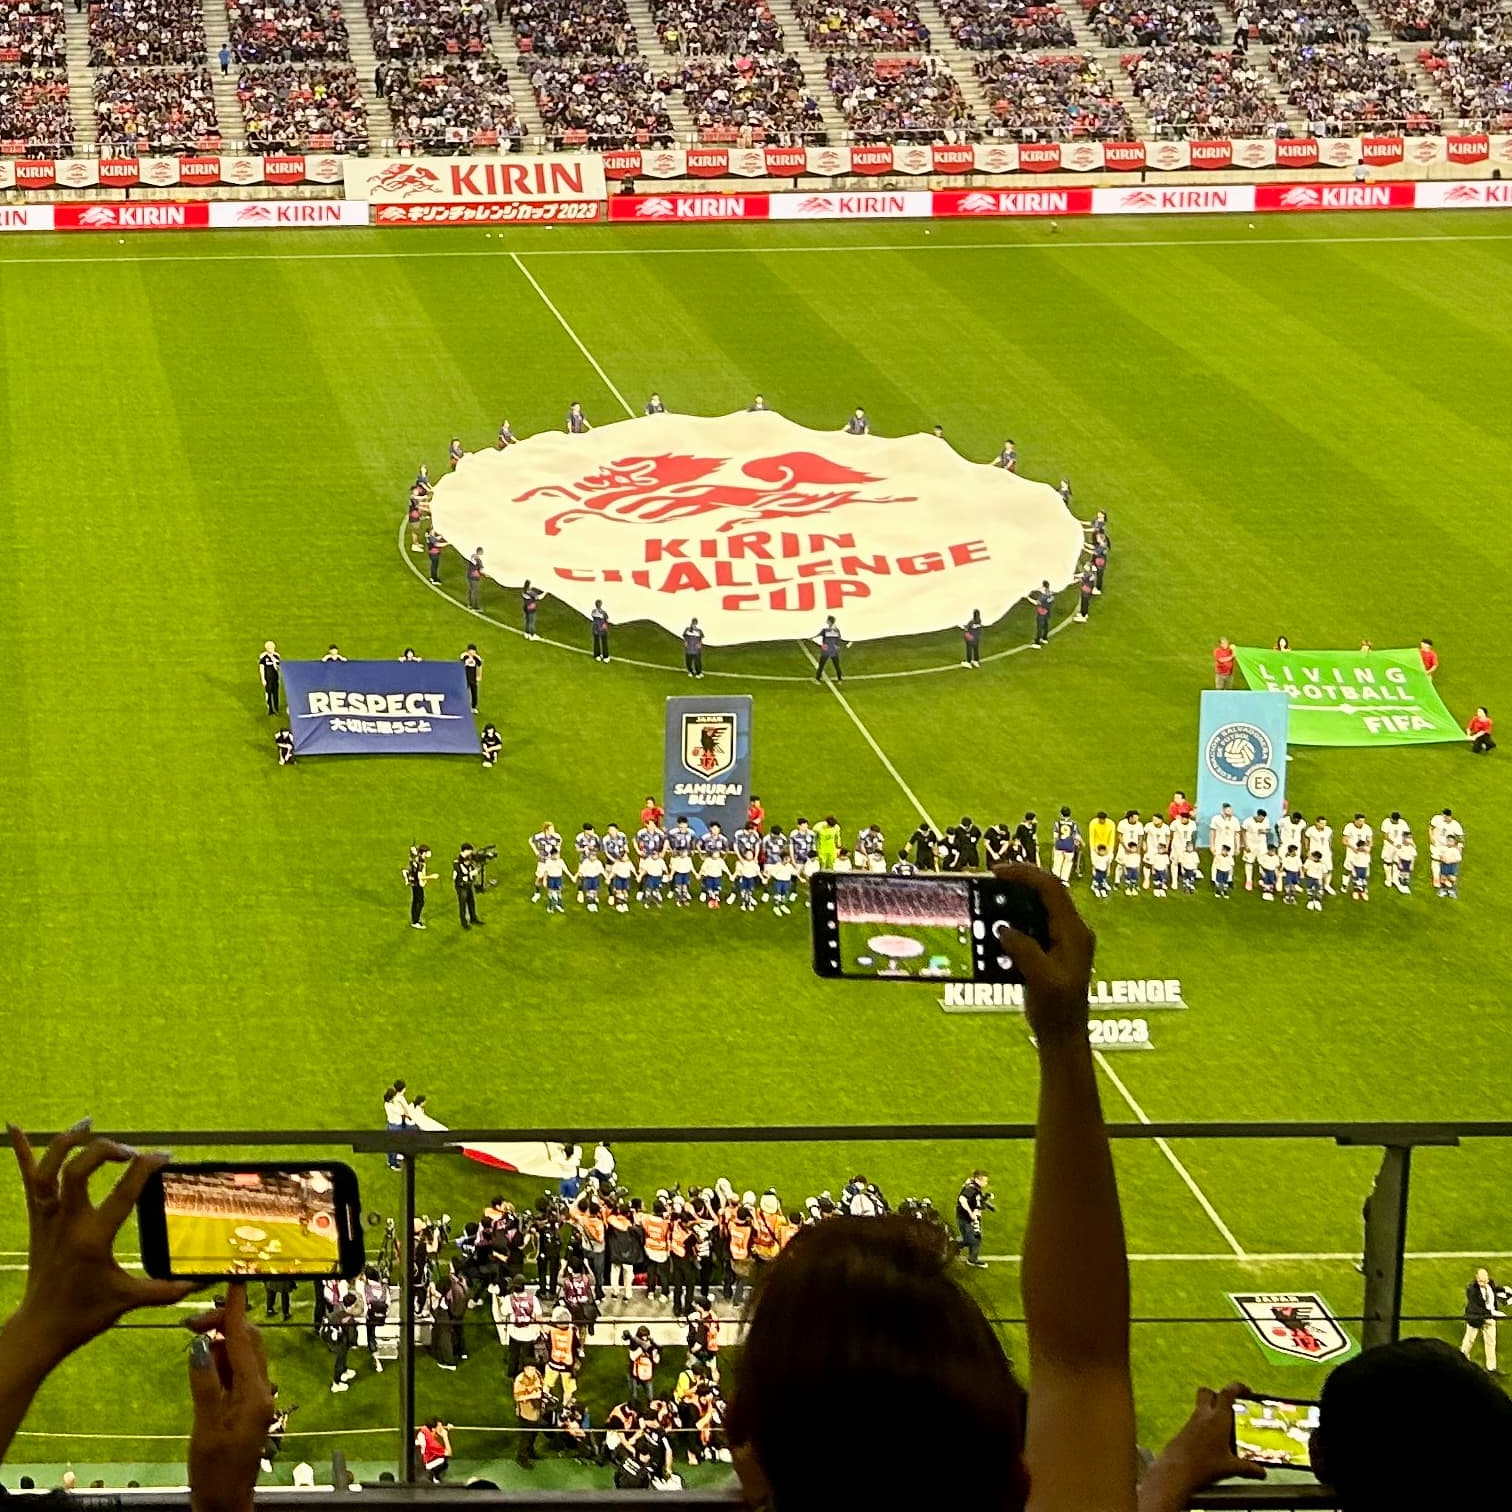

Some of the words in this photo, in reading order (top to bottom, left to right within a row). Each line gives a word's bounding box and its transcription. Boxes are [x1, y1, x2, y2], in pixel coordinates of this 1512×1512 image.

[1105, 148, 1145, 160] KIRIN
[1192, 146, 1231, 159] KIRIN
[1278, 144, 1318, 157] KIRIN
[1363, 144, 1402, 157] KIRIN
[1448, 142, 1488, 155] KIRIN
[688, 155, 728, 167] KIRIN
[766, 154, 805, 166] KIRIN
[852, 152, 892, 165] KIRIN
[933, 151, 973, 164] KIRIN
[1020, 150, 1060, 162] KIRIN
[181, 163, 219, 175] KIRIN
[265, 162, 304, 174] KIRIN
[604, 157, 642, 170] KIRIN
[16, 166, 54, 178] KIRIN
[100, 165, 138, 177] KIRIN
[450, 163, 584, 195] KIRIN
[1163, 190, 1227, 207] KIRIN
[1322, 187, 1390, 206] KIRIN
[1485, 185, 1512, 202] KI
[677, 197, 745, 217] KIRIN
[840, 196, 904, 213] KIRIN
[999, 192, 1068, 212] KIRIN
[118, 206, 186, 225] KIRIN
[277, 205, 342, 222] KIRIN
[408, 202, 556, 221] キリンチャレンジカップ
[557, 202, 598, 219] 2023
[644, 531, 855, 563] KIRIN
[722, 579, 871, 611] CUP
[1258, 664, 1407, 684] LIVING
[1266, 682, 1416, 701] FOOTBALL
[307, 691, 445, 717] RESPECT
[695, 715, 724, 723] JAPAN
[1361, 715, 1440, 734] FIFA
[698, 757, 719, 769] JFA
[673, 783, 743, 796] SAMURAI
[1254, 776, 1272, 790] ES
[687, 794, 727, 806] BLUE
[944, 982, 1025, 1006] KIRIN
[1087, 979, 1182, 1004] LLENGE
[1088, 1018, 1149, 1044] 2023
[1255, 1295, 1300, 1303] JAPAN
